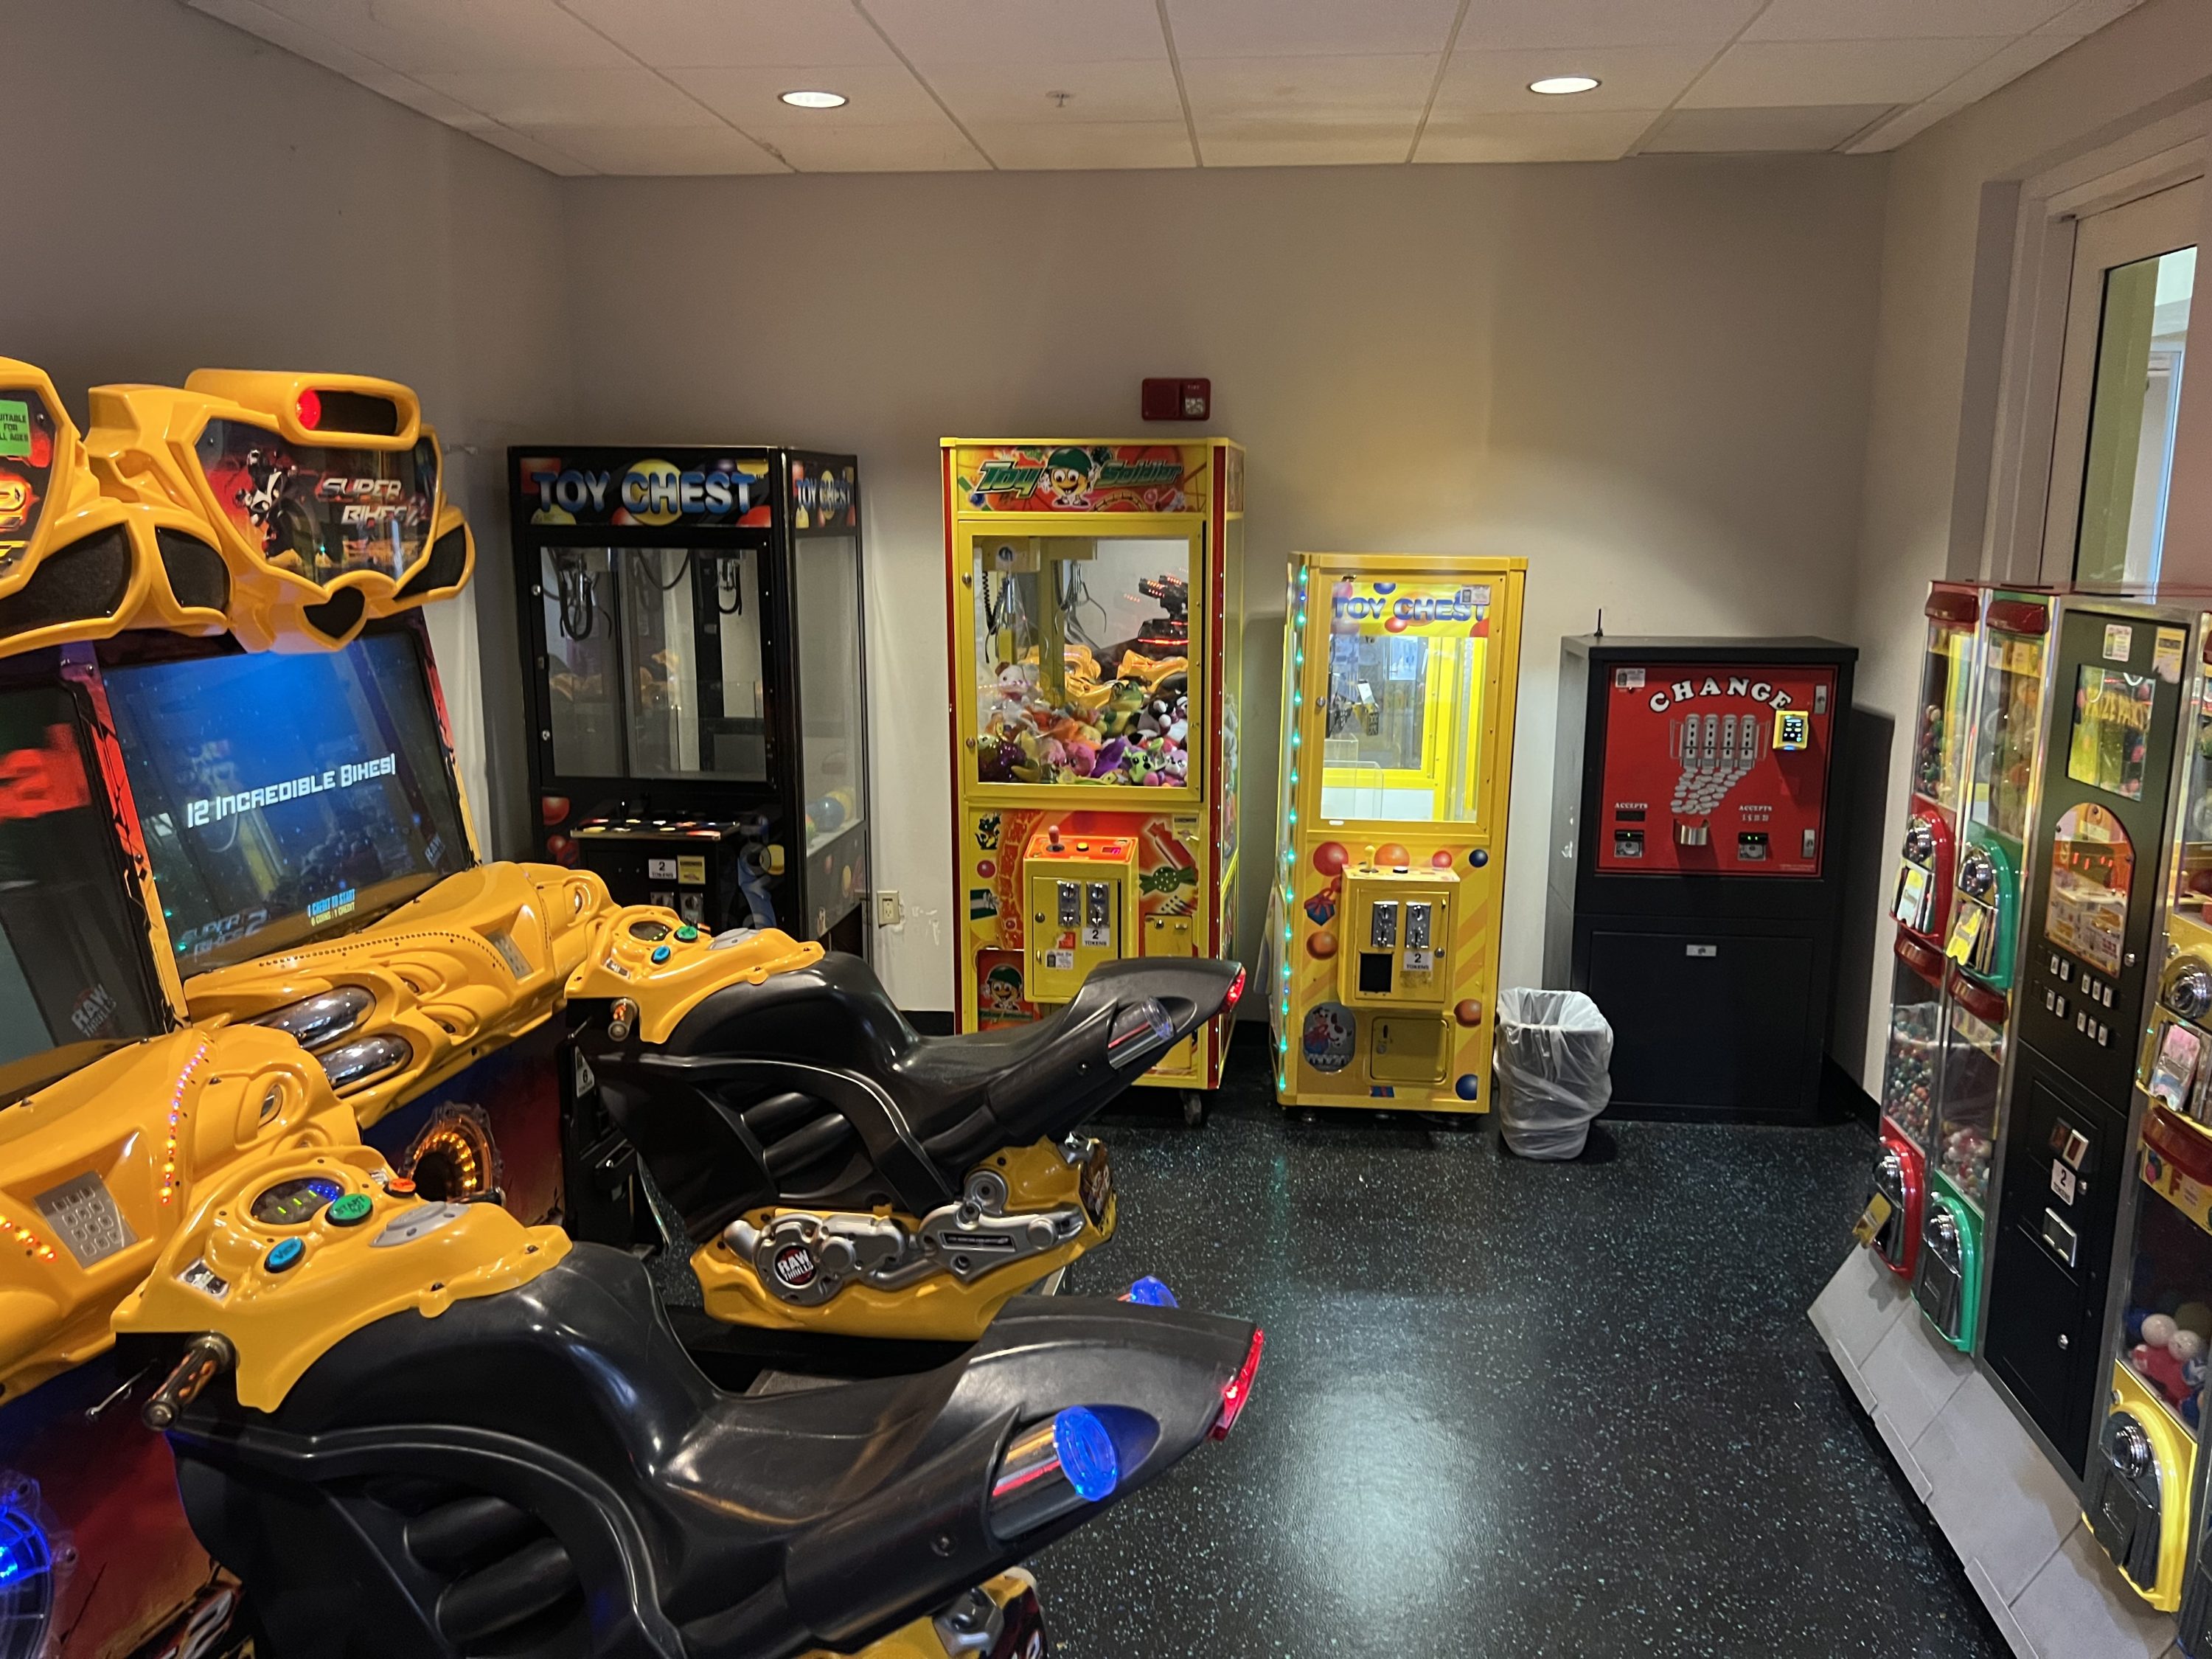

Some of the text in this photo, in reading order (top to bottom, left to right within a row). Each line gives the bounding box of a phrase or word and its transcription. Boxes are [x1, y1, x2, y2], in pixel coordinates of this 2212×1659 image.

[322, 478, 402, 497] SUPER
[973, 459, 1183, 500] Toy Soldier
[532, 469, 756, 515] TOY CHEST
[796, 477, 850, 512] TOY CHEST
[341, 505, 408, 524] BIKES
[1332, 597, 1386, 619] TOY
[1649, 676, 1792, 713] CHANGE
[187, 799, 210, 829] 12
[658, 861, 666, 872] 2
[1092, 929, 1099, 939] 2
[1414, 953, 1422, 964] 2
[71, 983, 108, 1031] RAW
[2060, 1168, 2067, 1187] 2
[777, 1249, 810, 1275] RAW
